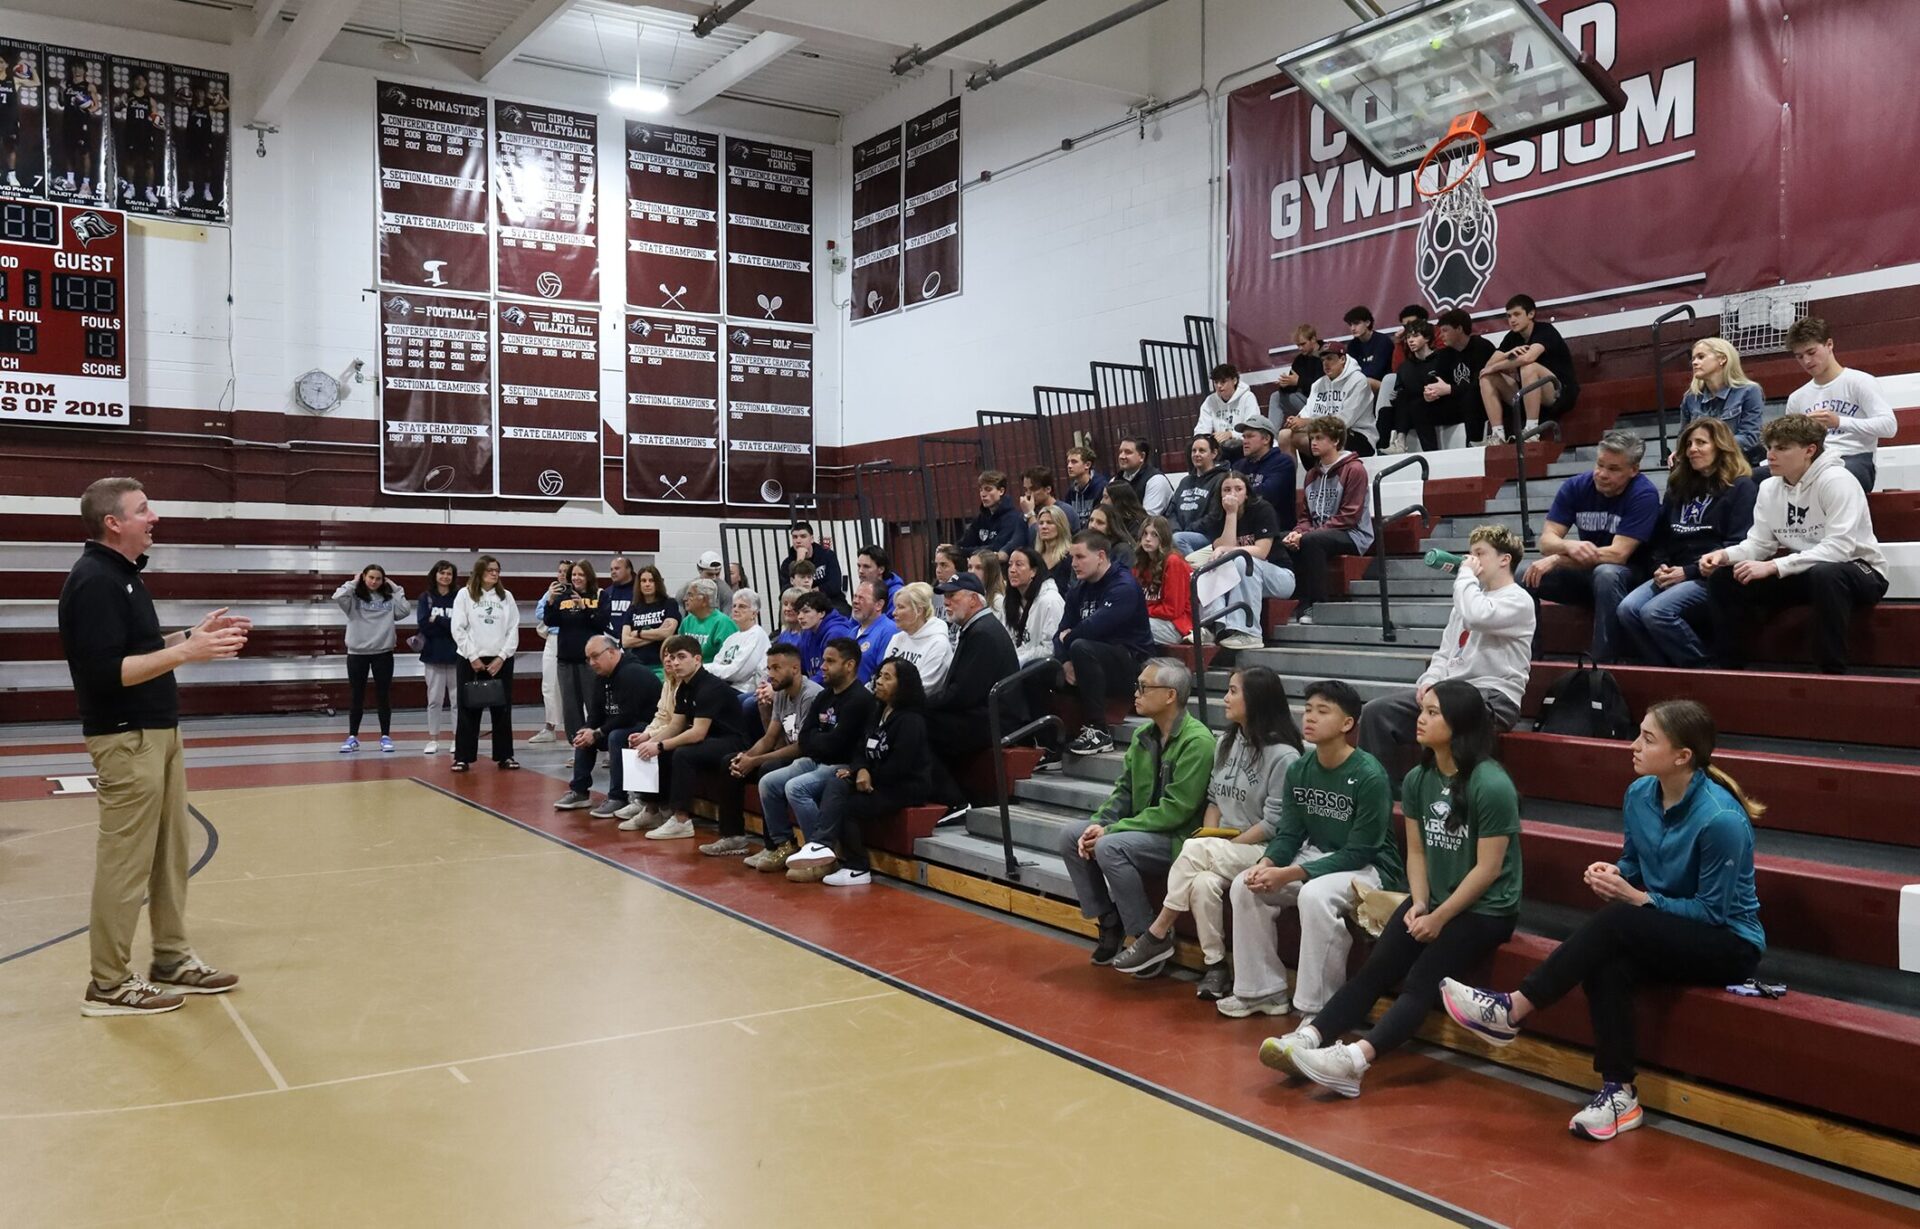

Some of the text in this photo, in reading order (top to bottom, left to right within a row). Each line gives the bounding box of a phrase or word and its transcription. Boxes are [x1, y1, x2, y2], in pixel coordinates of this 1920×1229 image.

[416, 97, 480, 117] GYMNASTICS
[388, 115, 478, 137] CONFERENCE CHAMPIONS
[547, 113, 574, 126] GIRLS
[531, 121, 591, 139] VOLLEYBALL
[505, 133, 588, 153] CONFERENCE CHAMPIONS
[673, 132, 698, 145] GIRLS
[664, 141, 706, 157] LACROSSE
[770, 148, 793, 161] GIRLS
[634, 152, 711, 171] CONFERENCE CHAMPIONS
[767, 158, 797, 171] TENNIS
[389, 170, 432, 184] SECTIONAL
[733, 167, 805, 186] CONFERENCE CHAMPIONS
[635, 201, 671, 214] SECTIONAL
[672, 207, 710, 219] CHAMPIONS
[394, 214, 475, 232] STATE CHAMPIONS
[734, 215, 805, 232] SECTIONAL CHAMPIONS
[511, 228, 586, 244] STATE CHAMPIONS
[639, 242, 707, 258] STATE CHAMPIONS
[54, 251, 114, 273] GUEST
[738, 254, 802, 270] STATE CHAMPIONS
[9, 309, 42, 323] FOUL
[426, 306, 476, 320] FOOTBALL
[551, 312, 575, 324] BOYS
[81, 316, 121, 330] FOULS
[533, 321, 593, 336] VOLLEYBALL
[675, 324, 697, 335] BOYS
[391, 325, 481, 341] CONFERENCE CHAMPIONS
[664, 333, 707, 346] LACROSSE
[507, 334, 591, 350] CONFERENCE CHAMPIONS
[772, 339, 792, 349] GOLF
[634, 345, 711, 360] CONFERENCE CHAMPIONS
[82, 362, 122, 376] SCORE
[735, 355, 806, 369] CONFERENCE CHAMPIONS
[393, 379, 481, 393] SECTIONAL CHAMPIONS
[508, 386, 590, 400] SECTIONAL CHAMPIONS
[25, 398, 58, 413] OF
[65, 400, 124, 418] 2016
[634, 395, 710, 408] SECTIONAL CHAMPIONS
[735, 403, 804, 415] SECTIONAL CHAMPIONS
[398, 422, 478, 435] STATE CHAMPIONS
[513, 428, 587, 441] STATE CHAMPIONS
[639, 435, 707, 447] STATE CHAMPIONS
[739, 441, 802, 452] STATE CHAMPIONS
[632, 609, 665, 622] ENDICOTT
[633, 617, 663, 627] FOOTBALL
